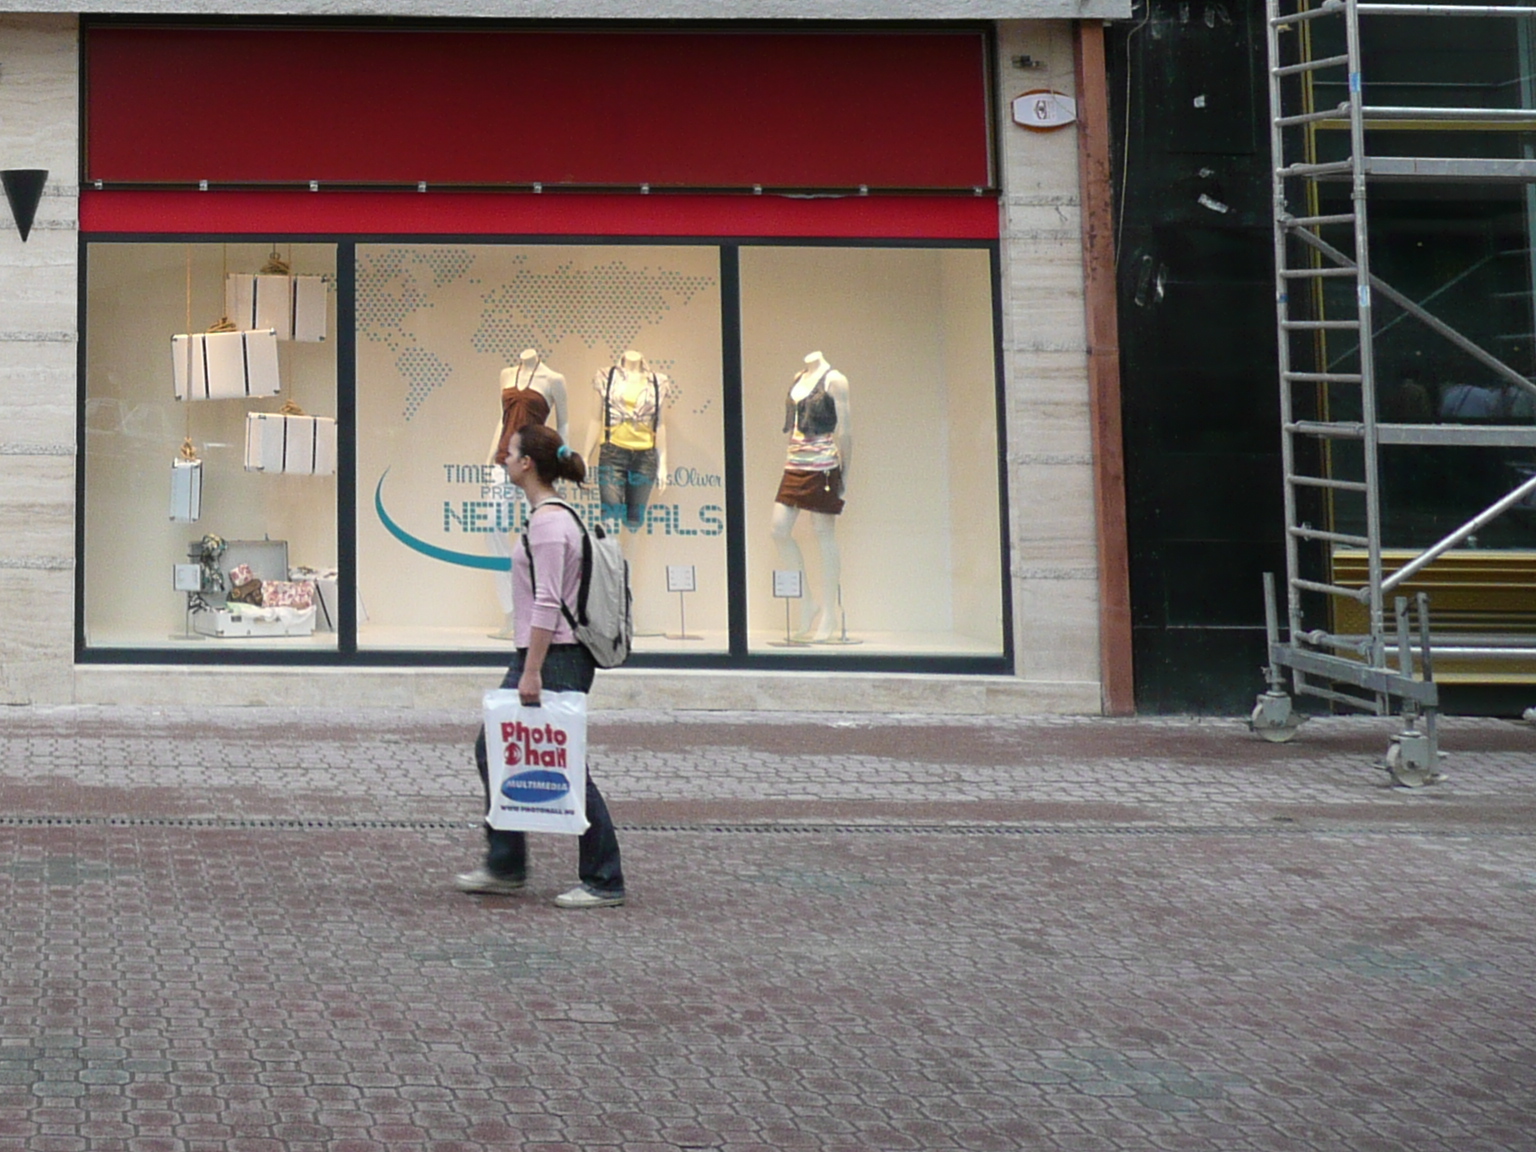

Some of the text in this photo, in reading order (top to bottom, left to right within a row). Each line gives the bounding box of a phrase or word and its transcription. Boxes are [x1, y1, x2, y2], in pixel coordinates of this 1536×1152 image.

[443, 464, 496, 483] TIME
[666, 466, 722, 488] s.Oliver
[481, 486, 599, 501] PRESS THE
[443, 501, 528, 533] NEW
[507, 779, 568, 791] MULTIMEDIA
